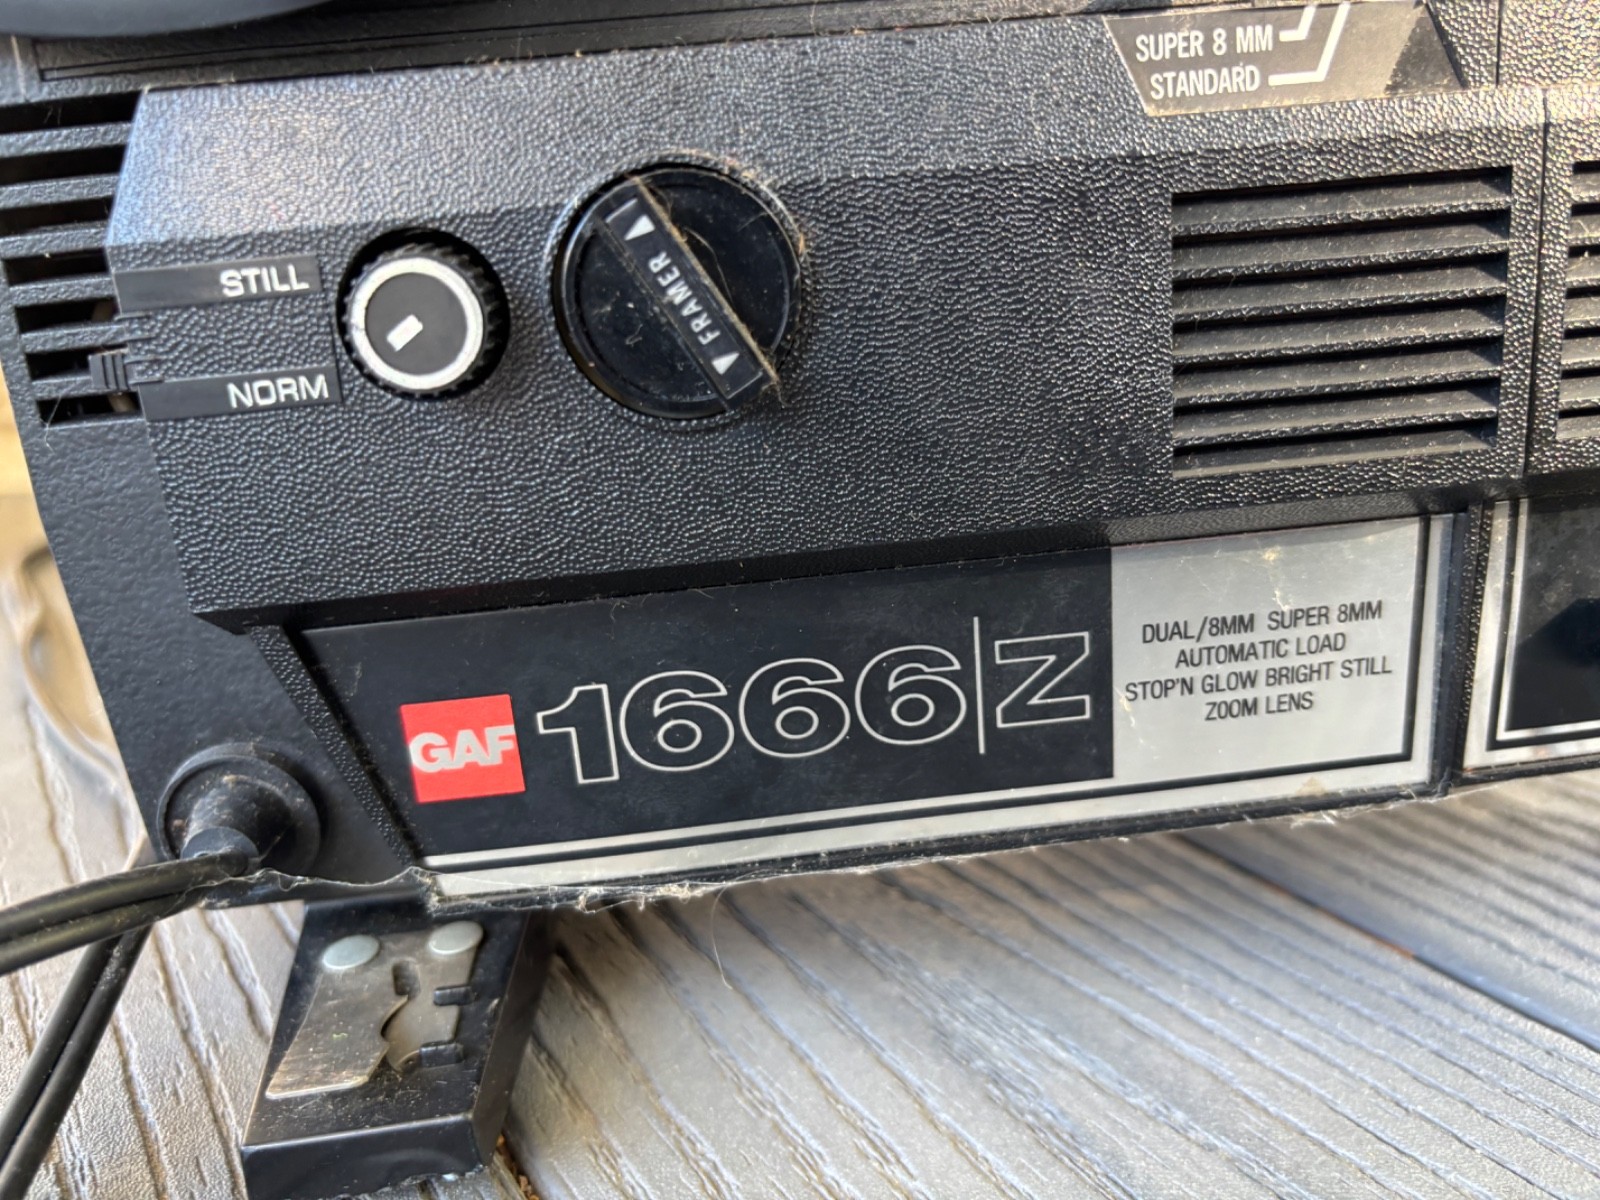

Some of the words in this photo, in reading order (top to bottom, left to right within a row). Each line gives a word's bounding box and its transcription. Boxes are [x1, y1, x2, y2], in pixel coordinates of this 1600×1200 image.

[1136, 30, 1205, 62] SUPER
[1212, 27, 1228, 56] 8
[1235, 24, 1274, 53] MM
[1149, 64, 1261, 100] STANDARD
[219, 263, 310, 298] STILL
[647, 250, 722, 346] FRAMER
[226, 373, 330, 409] NORM
[1141, 613, 1255, 644] DUAL/8MM
[1266, 605, 1330, 631] SUPER
[1336, 600, 1383, 623] 8MM
[1174, 638, 1289, 669] AUTOMATIC
[1295, 632, 1347, 656] LOAD
[1124, 677, 1194, 702] STOP'N
[1201, 670, 1259, 694] GLOW
[1265, 661, 1336, 687] BRIGHT
[1340, 655, 1393, 679] STILL
[1204, 698, 1259, 721] ZOOM
[1265, 691, 1314, 715] LENS
[408, 724, 516, 774] GAF
